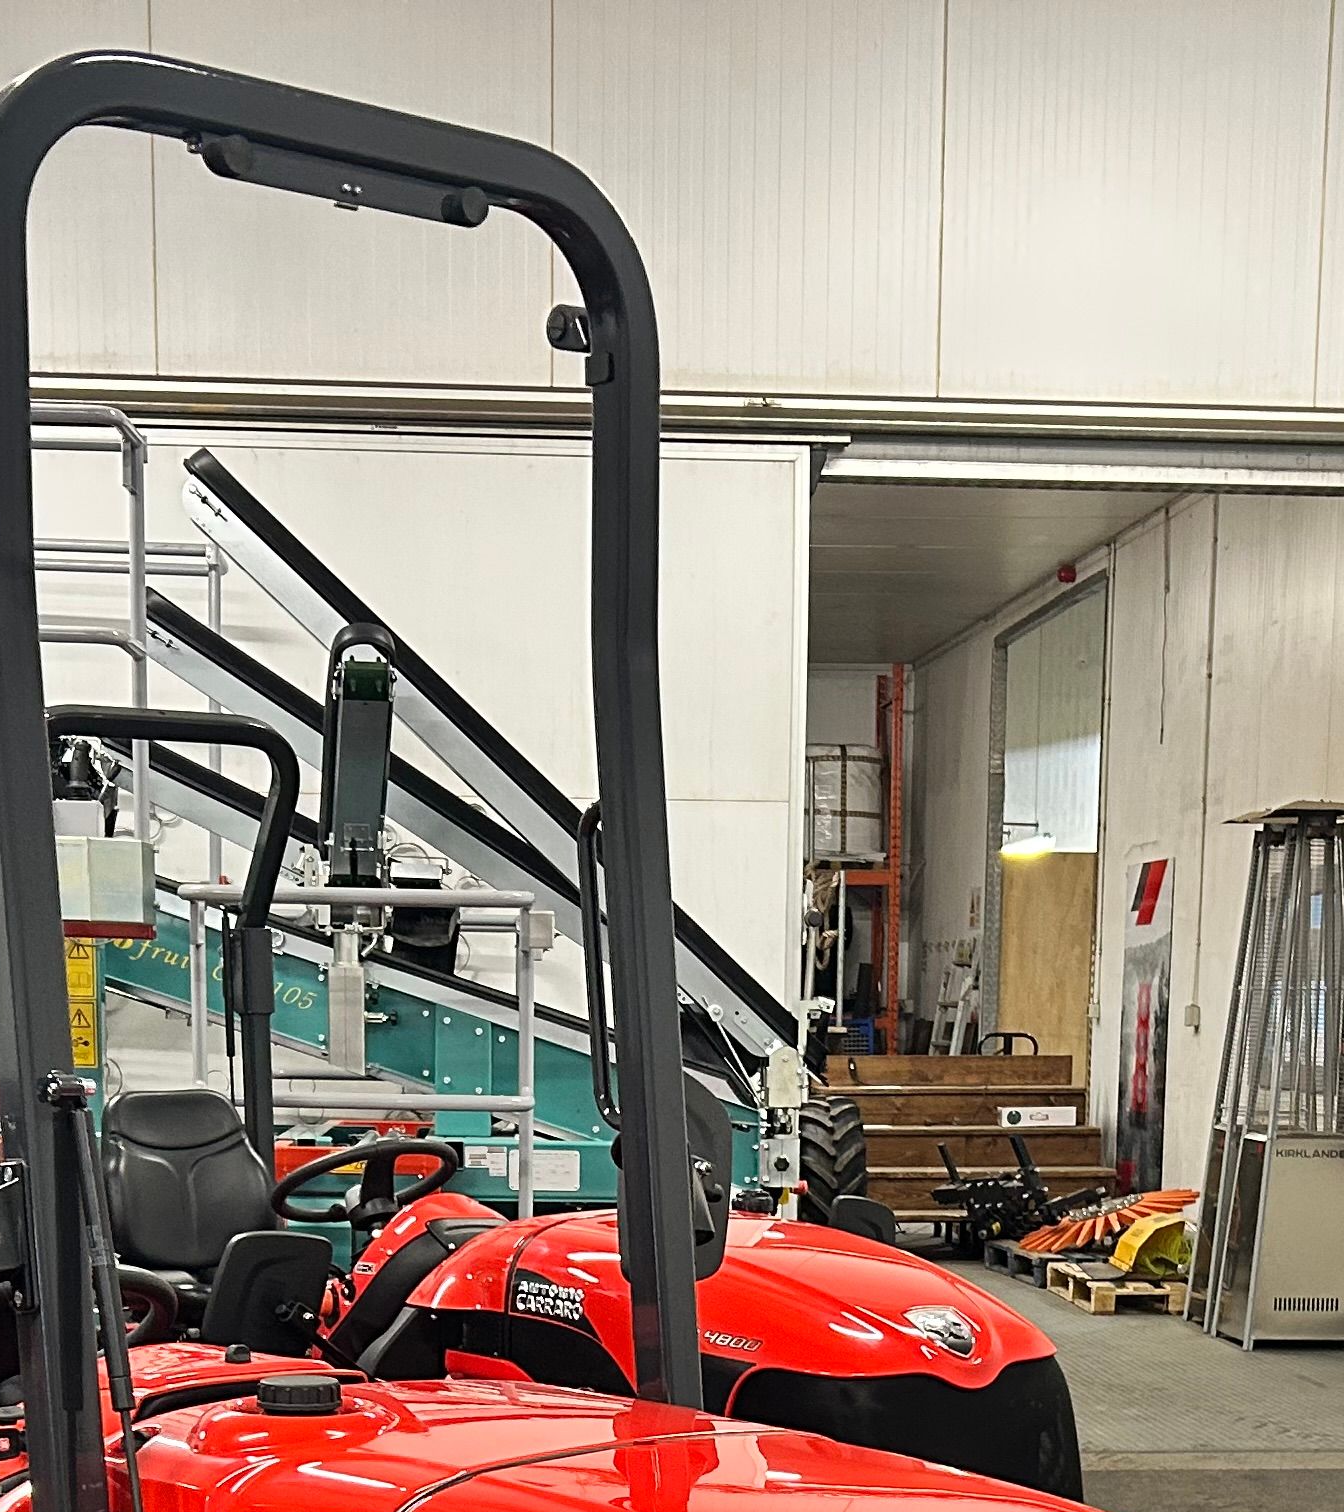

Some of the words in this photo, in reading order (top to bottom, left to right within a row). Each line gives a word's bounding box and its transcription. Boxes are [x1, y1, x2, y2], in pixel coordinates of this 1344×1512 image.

[1275, 1148, 1339, 1159] KIRKLAND
[516, 1293, 583, 1321] CARRARO
[702, 1329, 764, 1352] 4800
